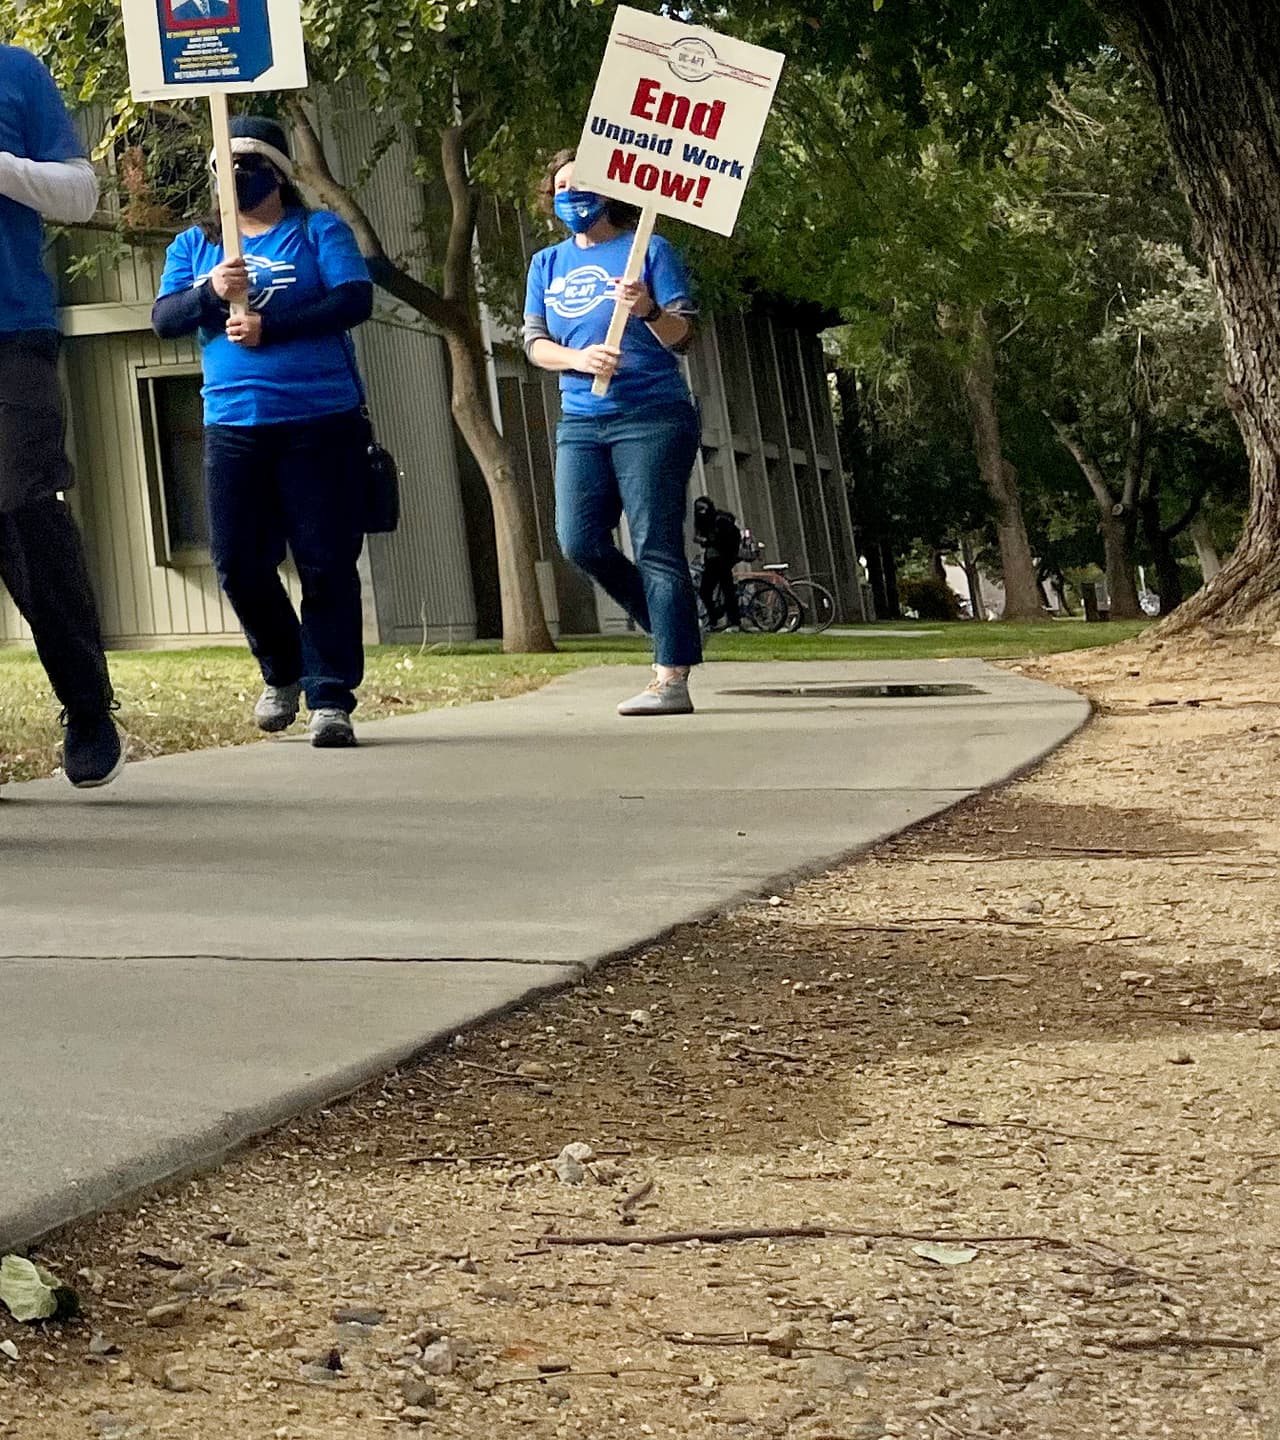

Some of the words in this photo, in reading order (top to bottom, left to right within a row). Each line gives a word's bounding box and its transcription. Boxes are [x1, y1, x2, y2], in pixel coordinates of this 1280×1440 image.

[629, 76, 728, 142] End
[590, 115, 674, 158] Unpaid
[682, 142, 746, 181] Work
[605, 148, 712, 209] Now!
